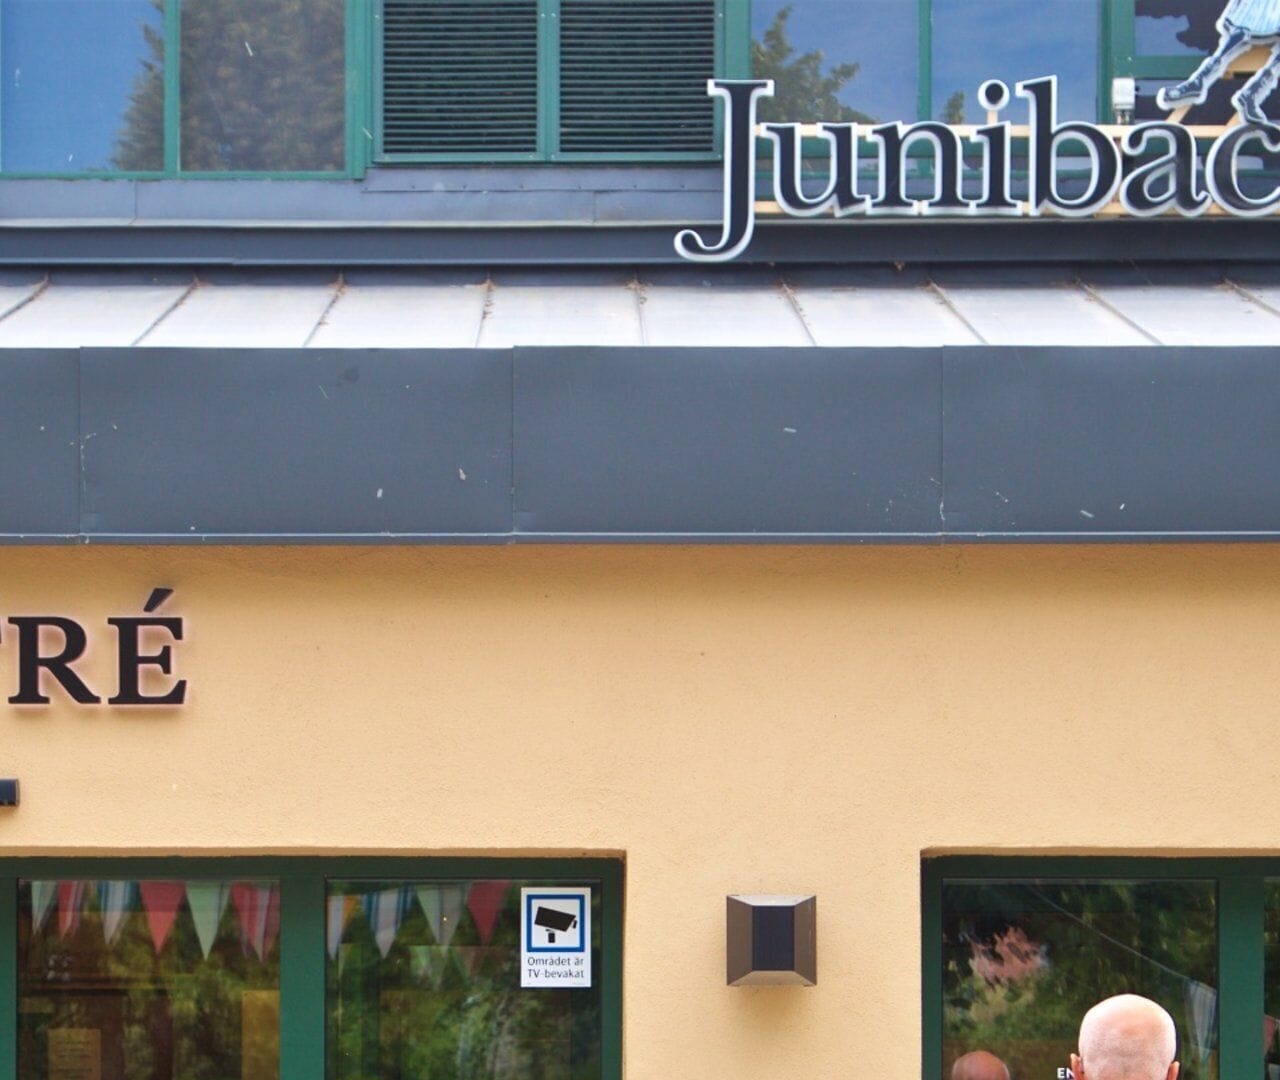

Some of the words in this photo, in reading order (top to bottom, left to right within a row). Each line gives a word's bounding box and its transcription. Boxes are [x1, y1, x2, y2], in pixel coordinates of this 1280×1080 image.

[527, 957, 571, 966] Området
[574, 957, 584, 966] är
[528, 969, 584, 978] TV-bevakat
